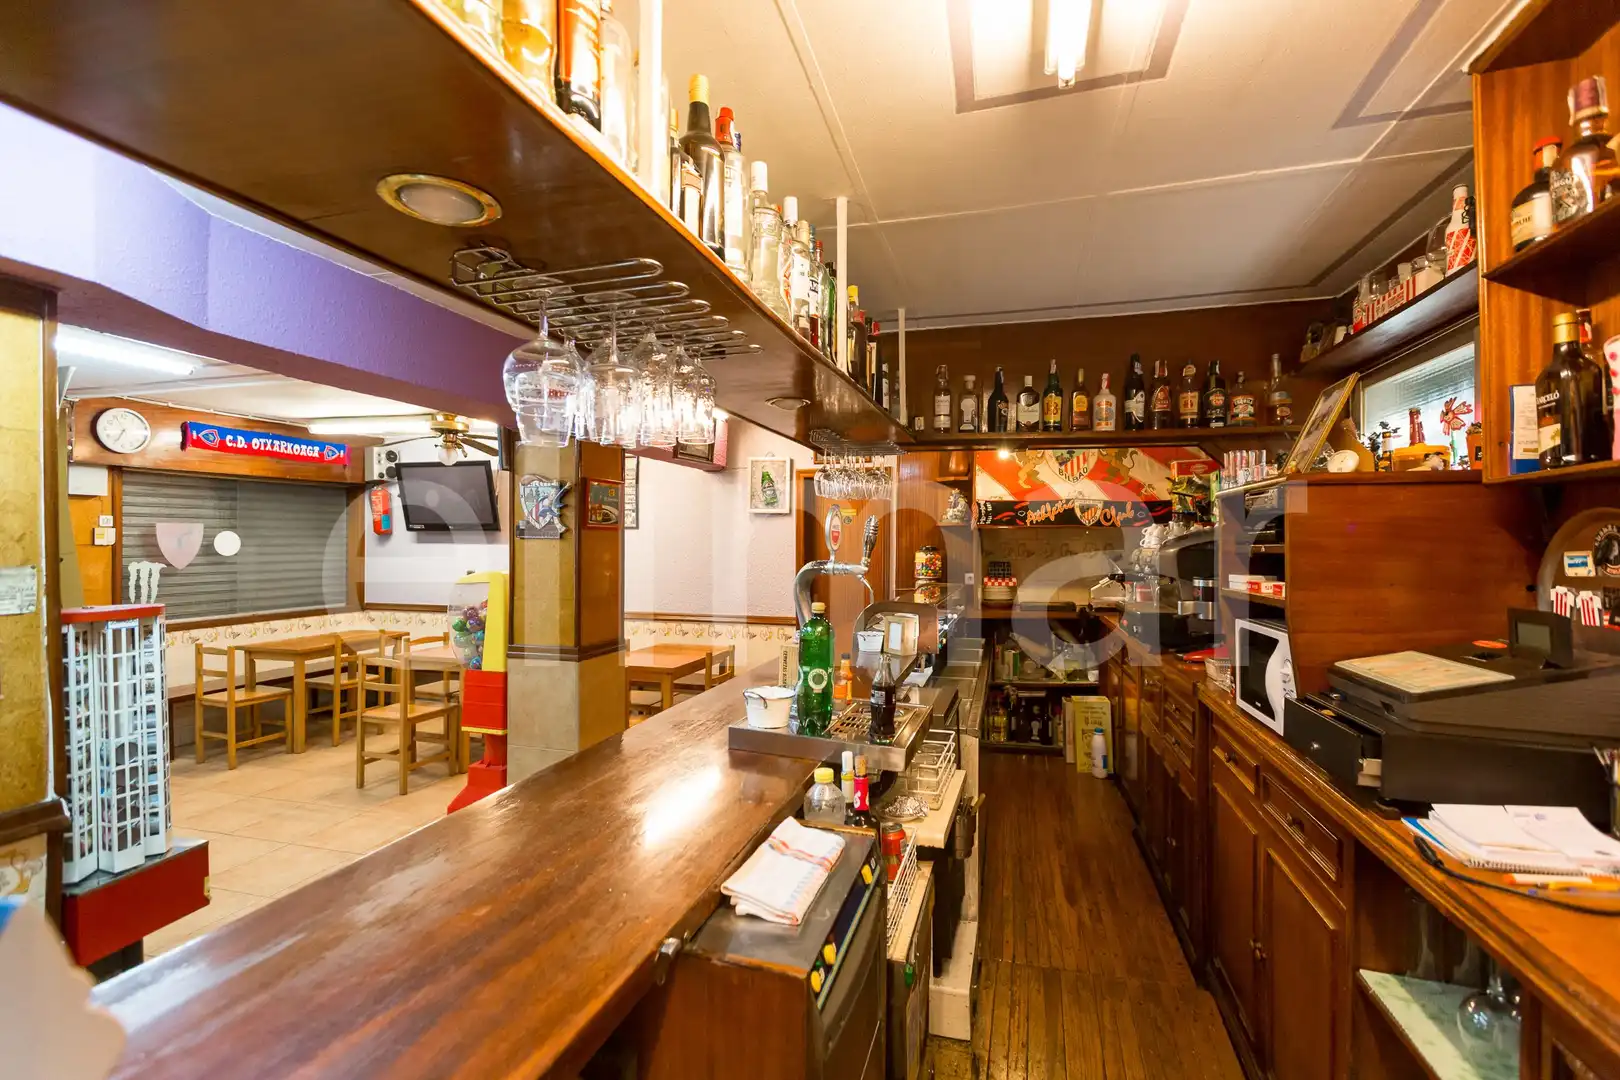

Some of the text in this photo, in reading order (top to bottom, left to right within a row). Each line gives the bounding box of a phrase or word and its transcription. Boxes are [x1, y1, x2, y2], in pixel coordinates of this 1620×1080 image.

[225, 434, 320, 458] C.D. OTXARKOAGA
[1058, 466, 1089, 484] BILBAO
[1100, 501, 1135, 527] Club
